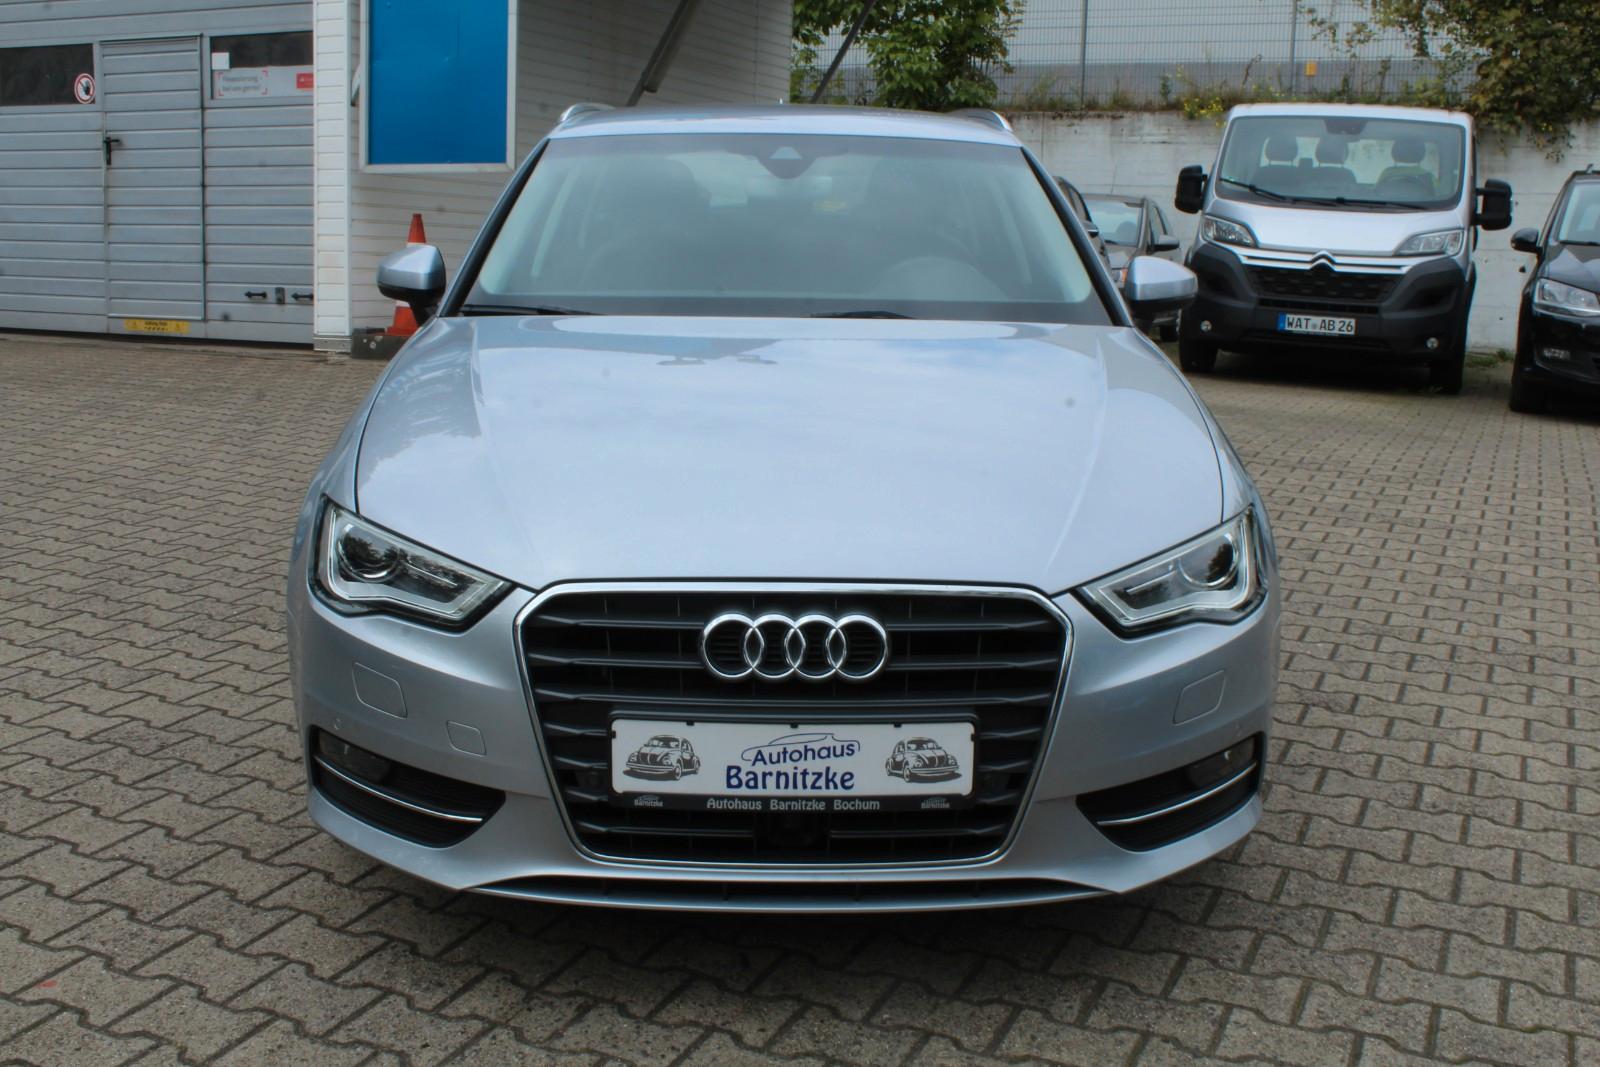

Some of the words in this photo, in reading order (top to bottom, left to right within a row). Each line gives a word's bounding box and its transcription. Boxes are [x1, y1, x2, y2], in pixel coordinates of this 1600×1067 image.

[1287, 316, 1311, 329] WAT
[1319, 318, 1336, 331] AB
[1338, 320, 1354, 333] 26
[751, 743, 855, 767] Autohaus
[726, 765, 855, 790] Barnitzke
[706, 798, 762, 811] Autohaus
[769, 799, 826, 811] Barnitzke
[833, 799, 880, 811] Bochum
